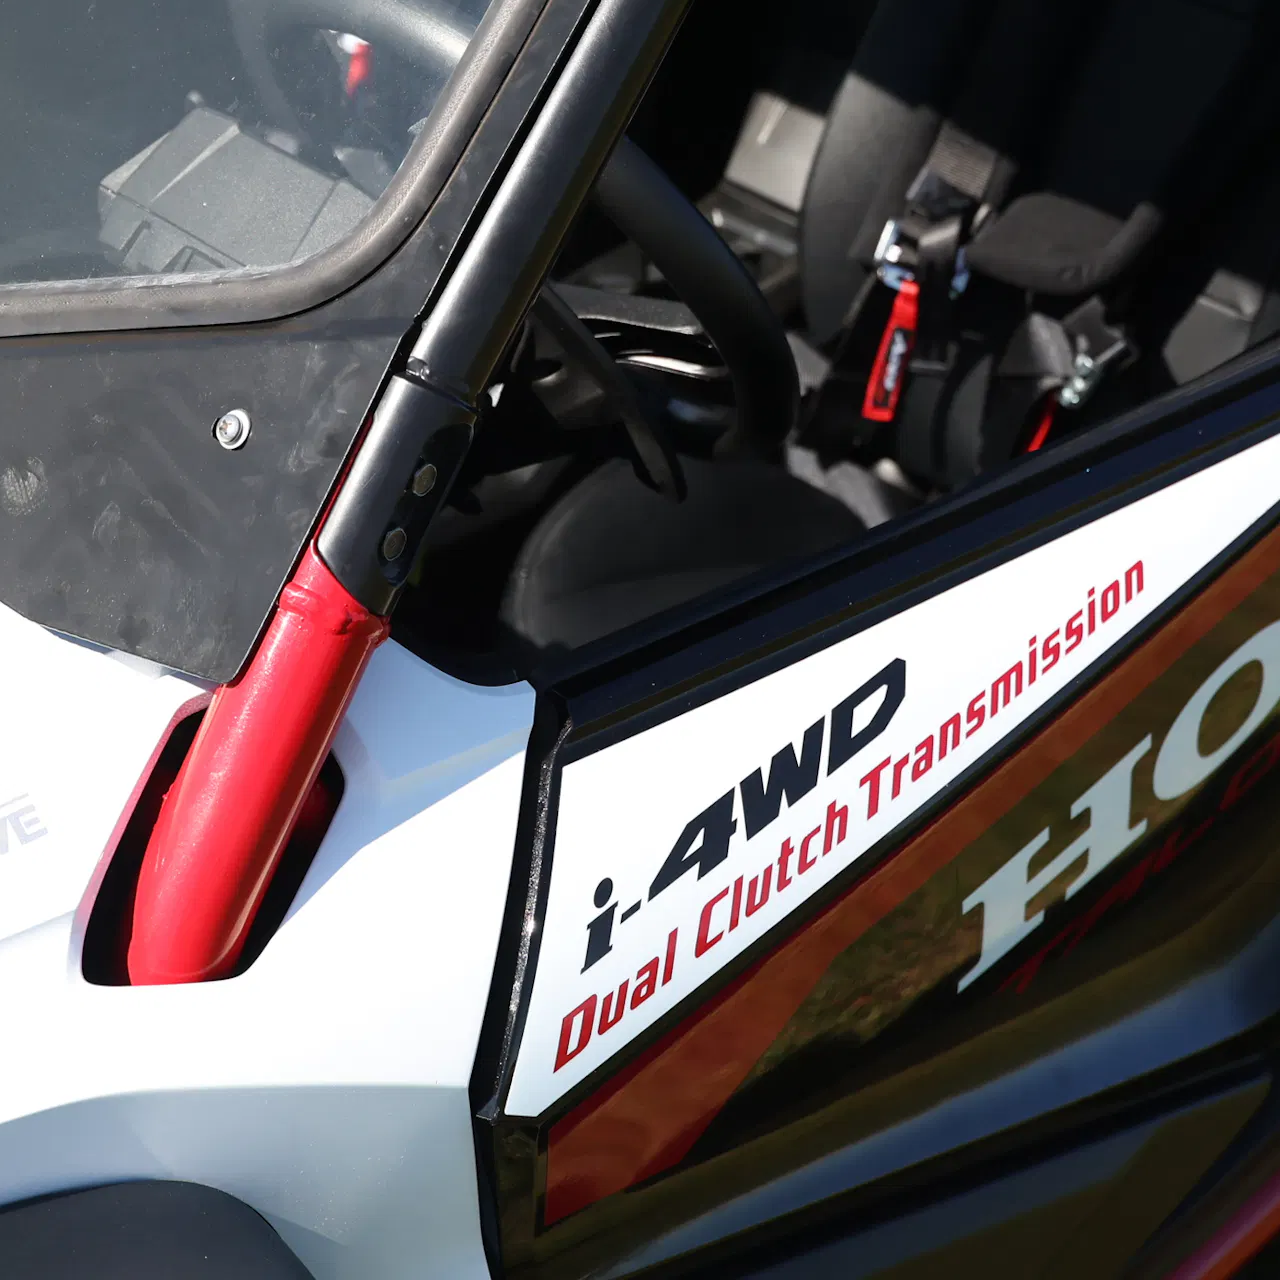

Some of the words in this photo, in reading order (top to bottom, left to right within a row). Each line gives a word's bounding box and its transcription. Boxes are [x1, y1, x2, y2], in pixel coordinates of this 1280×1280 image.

[553, 929, 679, 1074] Dual
[694, 801, 849, 959] Clutch
[859, 560, 1145, 821] Transmission
